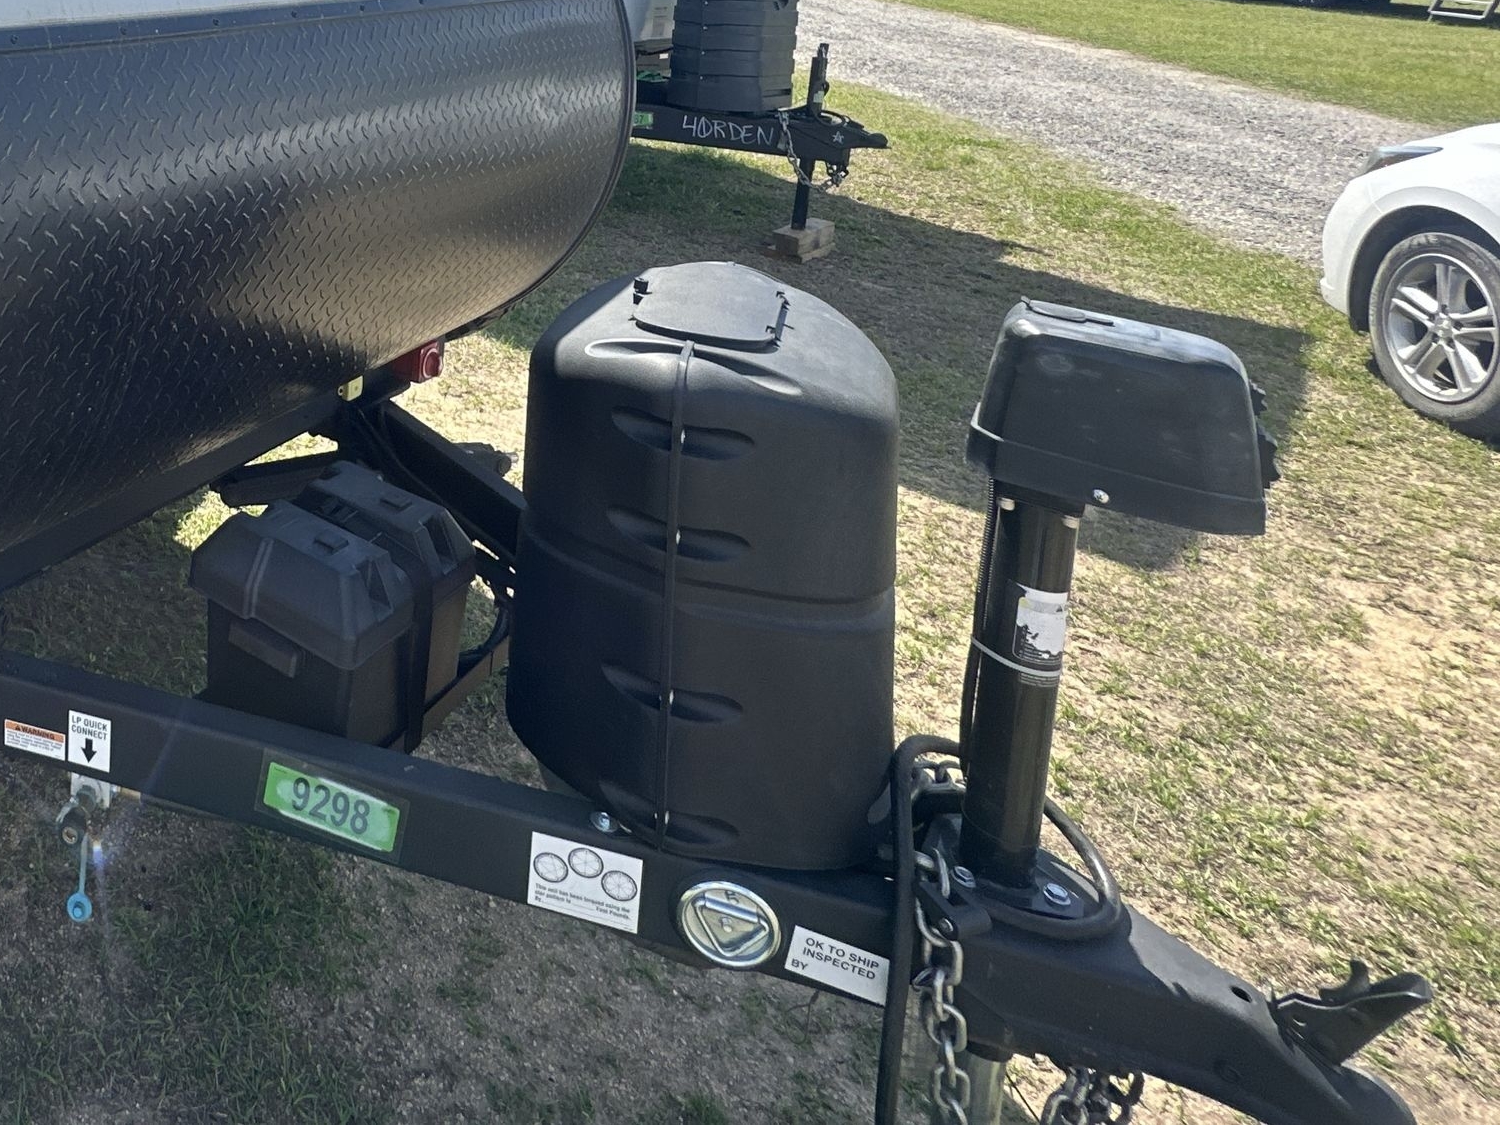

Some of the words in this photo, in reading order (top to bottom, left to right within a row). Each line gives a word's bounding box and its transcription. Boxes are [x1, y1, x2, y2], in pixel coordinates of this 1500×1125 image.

[19, 724, 56, 740] WARNING
[71, 715, 82, 724] LP
[83, 718, 108, 732] QUICK
[71, 724, 108, 741] CONNECT
[292, 777, 370, 835] 9298
[805, 937, 825, 950] OK
[828, 944, 846, 958] TO
[848, 953, 880, 969] SHIP
[791, 958, 809, 971] BY
[802, 947, 876, 980] INSPECTED
